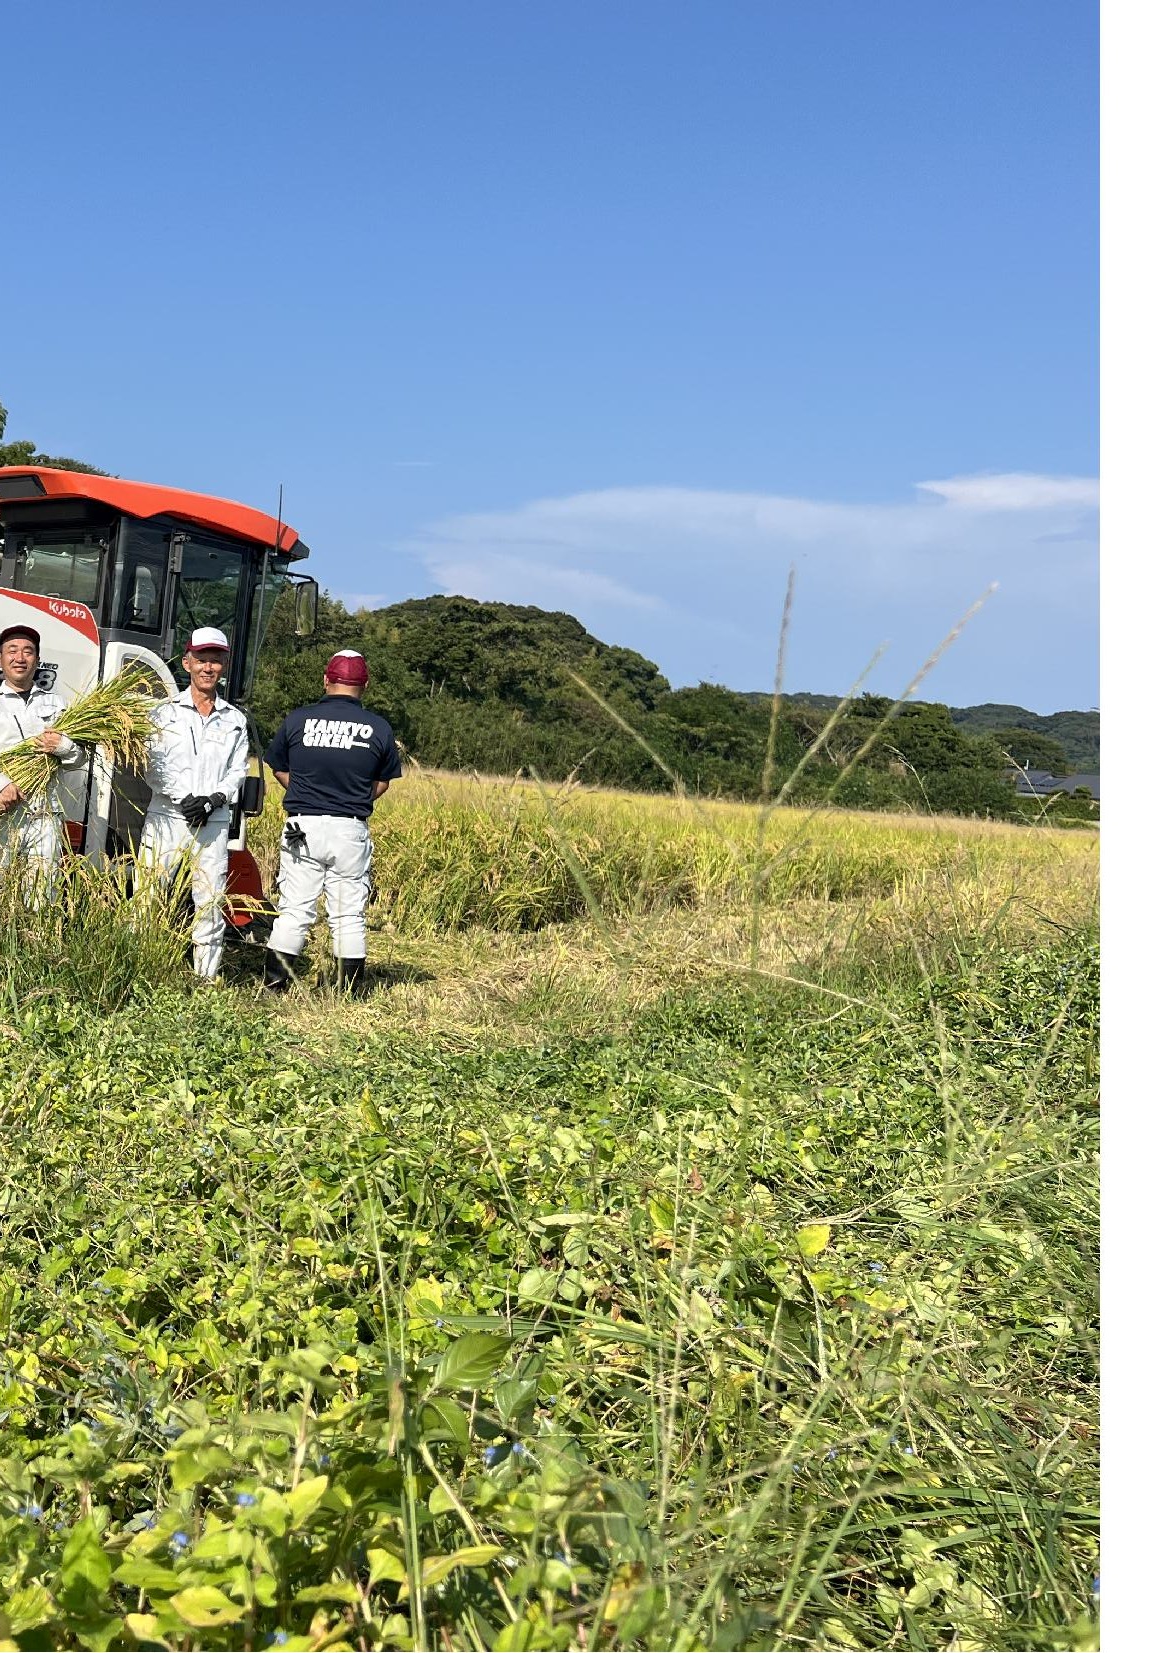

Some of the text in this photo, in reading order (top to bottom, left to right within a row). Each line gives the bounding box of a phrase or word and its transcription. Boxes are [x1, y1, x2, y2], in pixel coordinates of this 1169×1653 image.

[49, 600, 87, 619] Kubota
[304, 718, 374, 739] KANKYO
[302, 733, 354, 749] GIKEN
